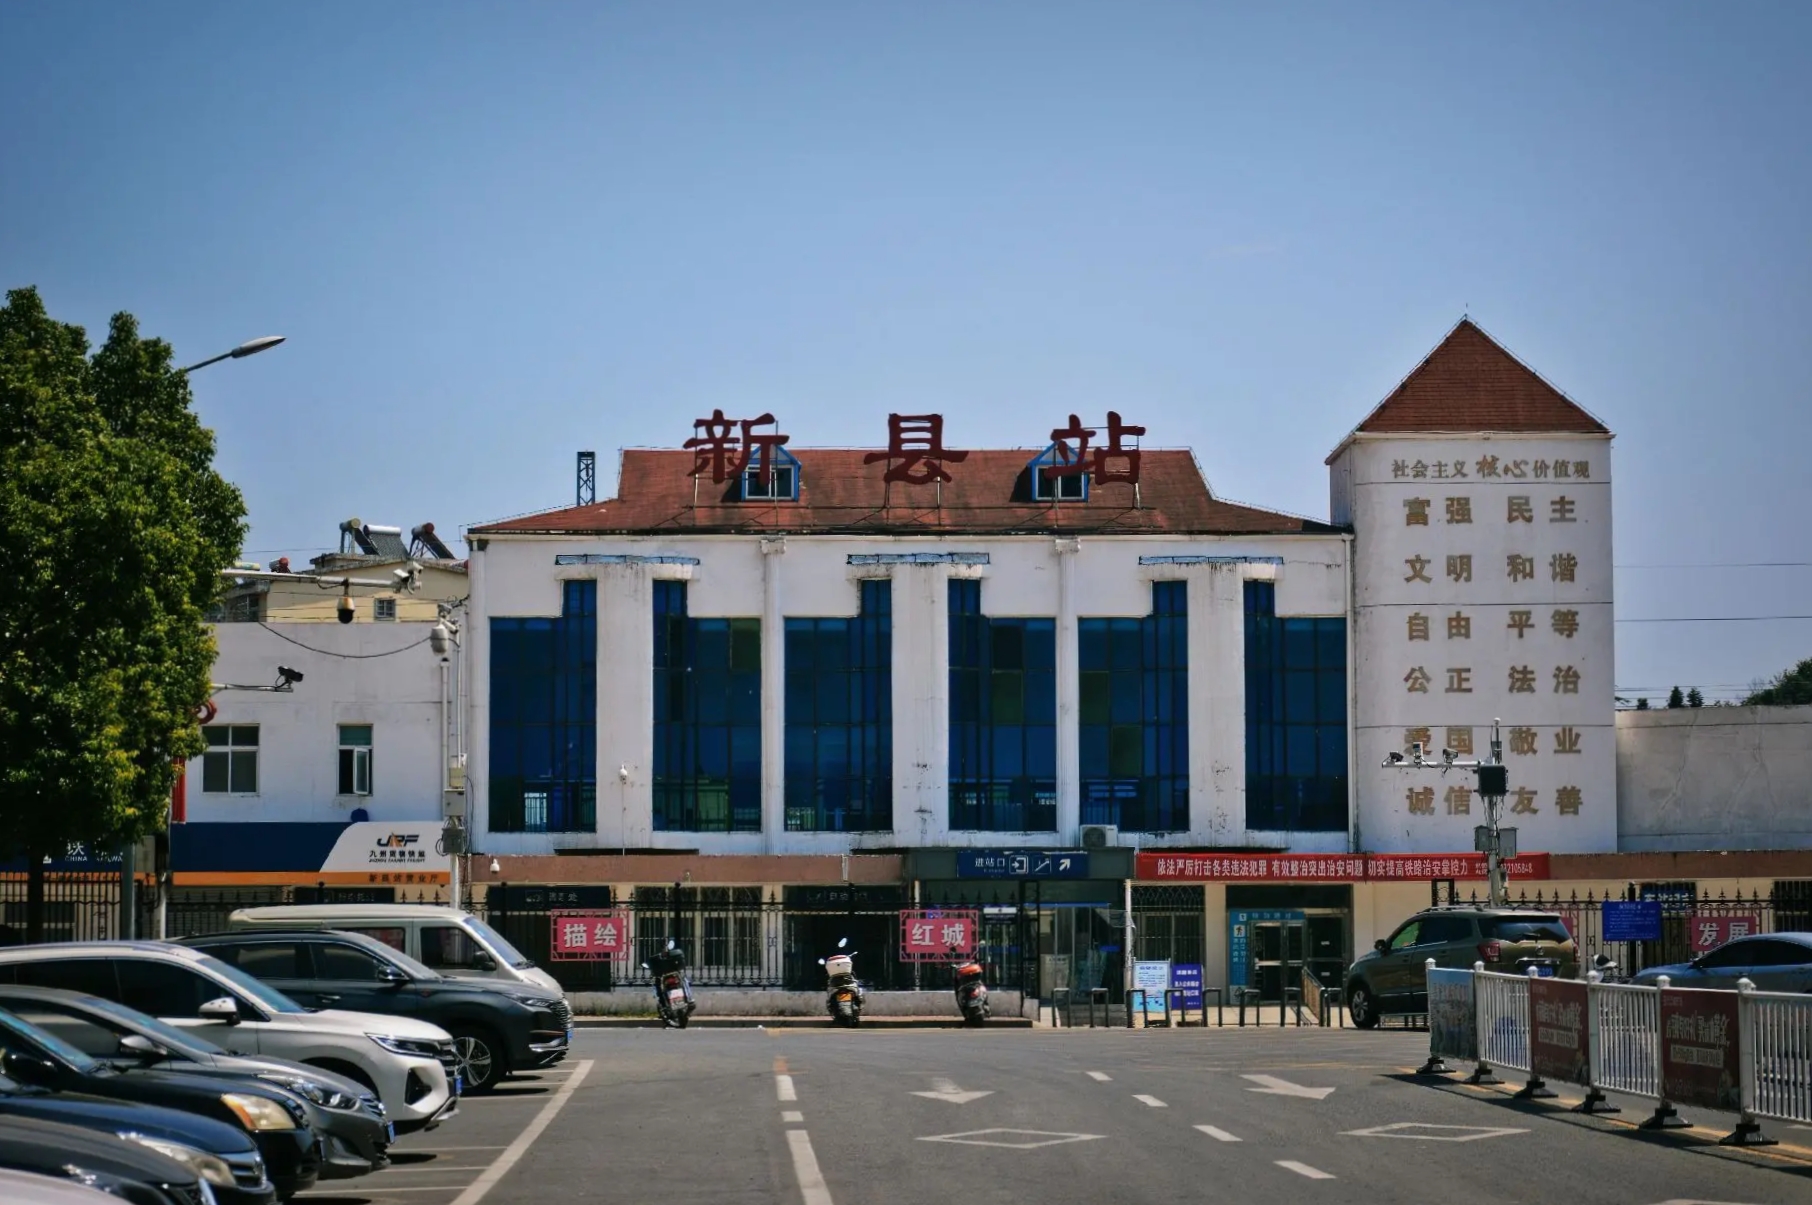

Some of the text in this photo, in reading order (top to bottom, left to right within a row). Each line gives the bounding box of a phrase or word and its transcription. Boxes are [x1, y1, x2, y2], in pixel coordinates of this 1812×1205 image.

[684, 409, 1146, 486] 新县站
[1391, 454, 1591, 479] 社会主义核心价值观
[1403, 496, 1577, 526] 富强 民主
[1404, 553, 1578, 583] 文明 和谐
[1406, 609, 1580, 641] 自由 平等
[1403, 665, 1581, 694] 公正 法治
[1404, 726, 1582, 756] 爱国 敬业
[1406, 786, 1584, 816] 诚信 友善
[975, 857, 1005, 868] 进站口
[1157, 858, 1267, 877] 依法严厉打击各类违法犯罪
[1272, 859, 1363, 877] 有效整治突出治安问题
[1367, 859, 1468, 877] 切实提高铁路治安掌控力
[564, 923, 617, 948] 描绘
[911, 924, 965, 947] 红城
[1698, 922, 1750, 946] 发展
